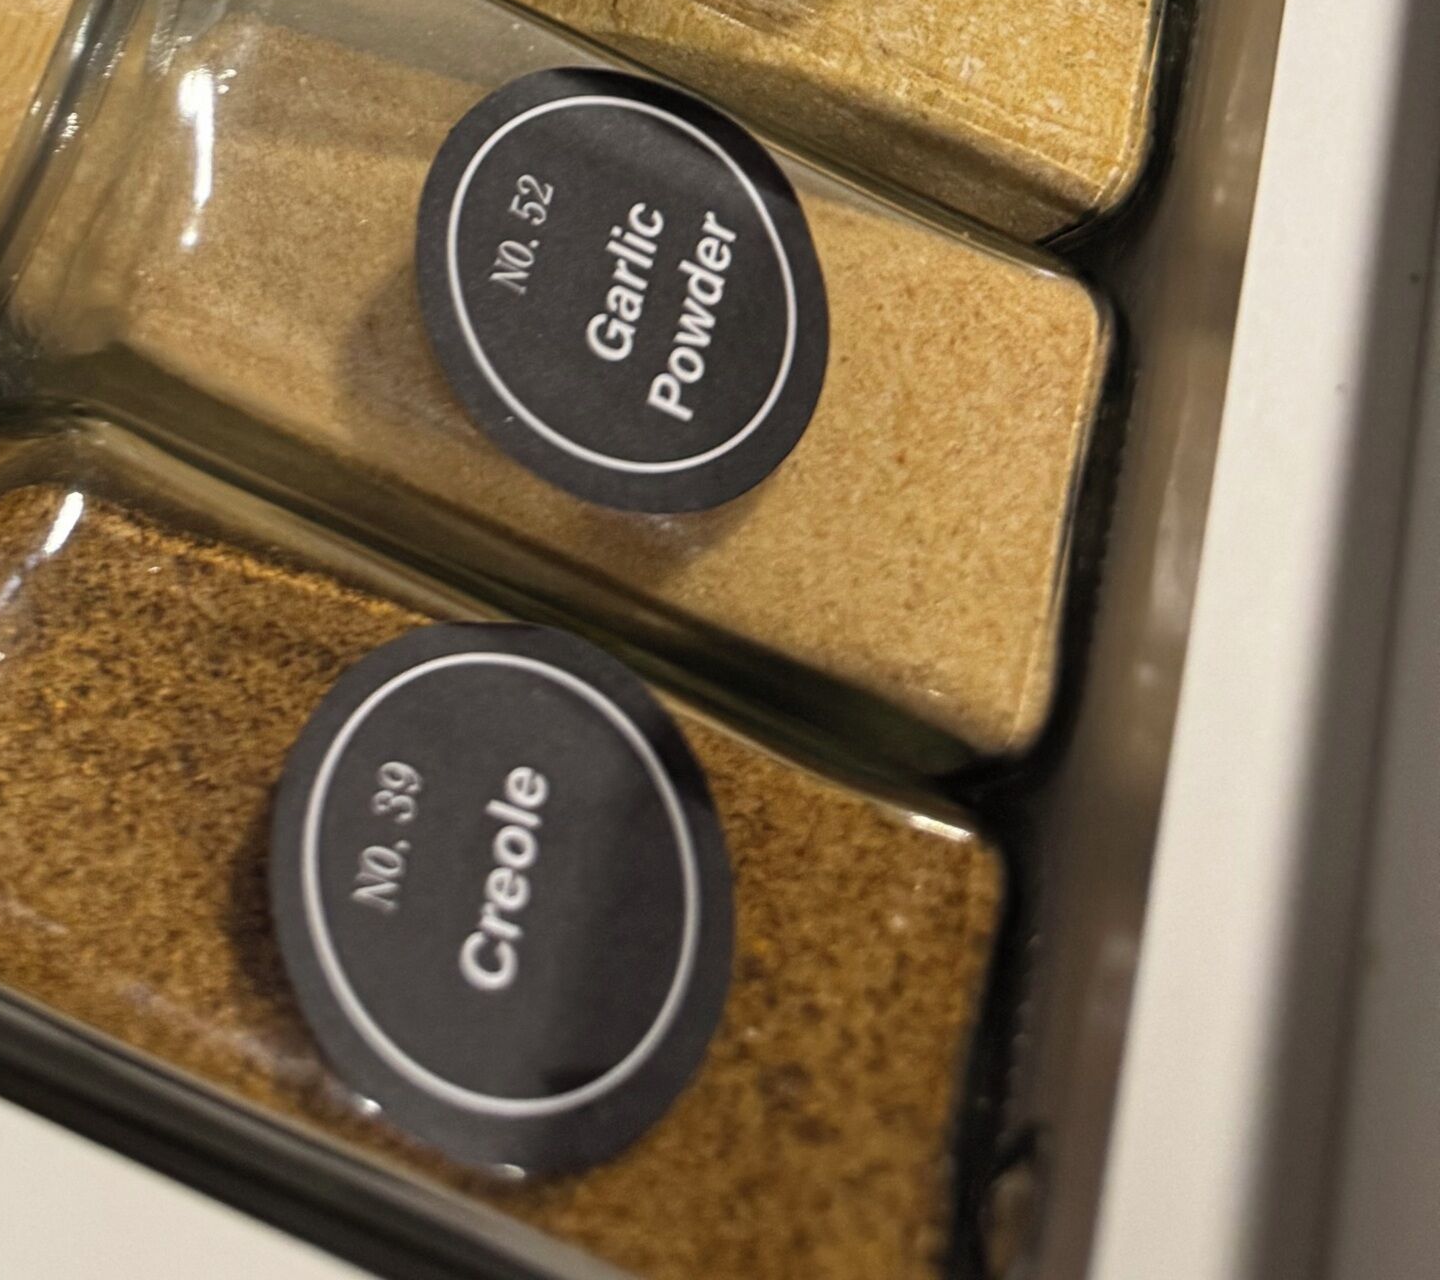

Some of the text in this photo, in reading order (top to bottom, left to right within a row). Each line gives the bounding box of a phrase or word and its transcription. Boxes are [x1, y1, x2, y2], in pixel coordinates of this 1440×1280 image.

[489, 174, 554, 294] NO. 52
[586, 202, 664, 362] Garlic
[647, 211, 737, 421] Powder
[352, 761, 421, 910] NO. 39
[459, 766, 548, 990] Creole
